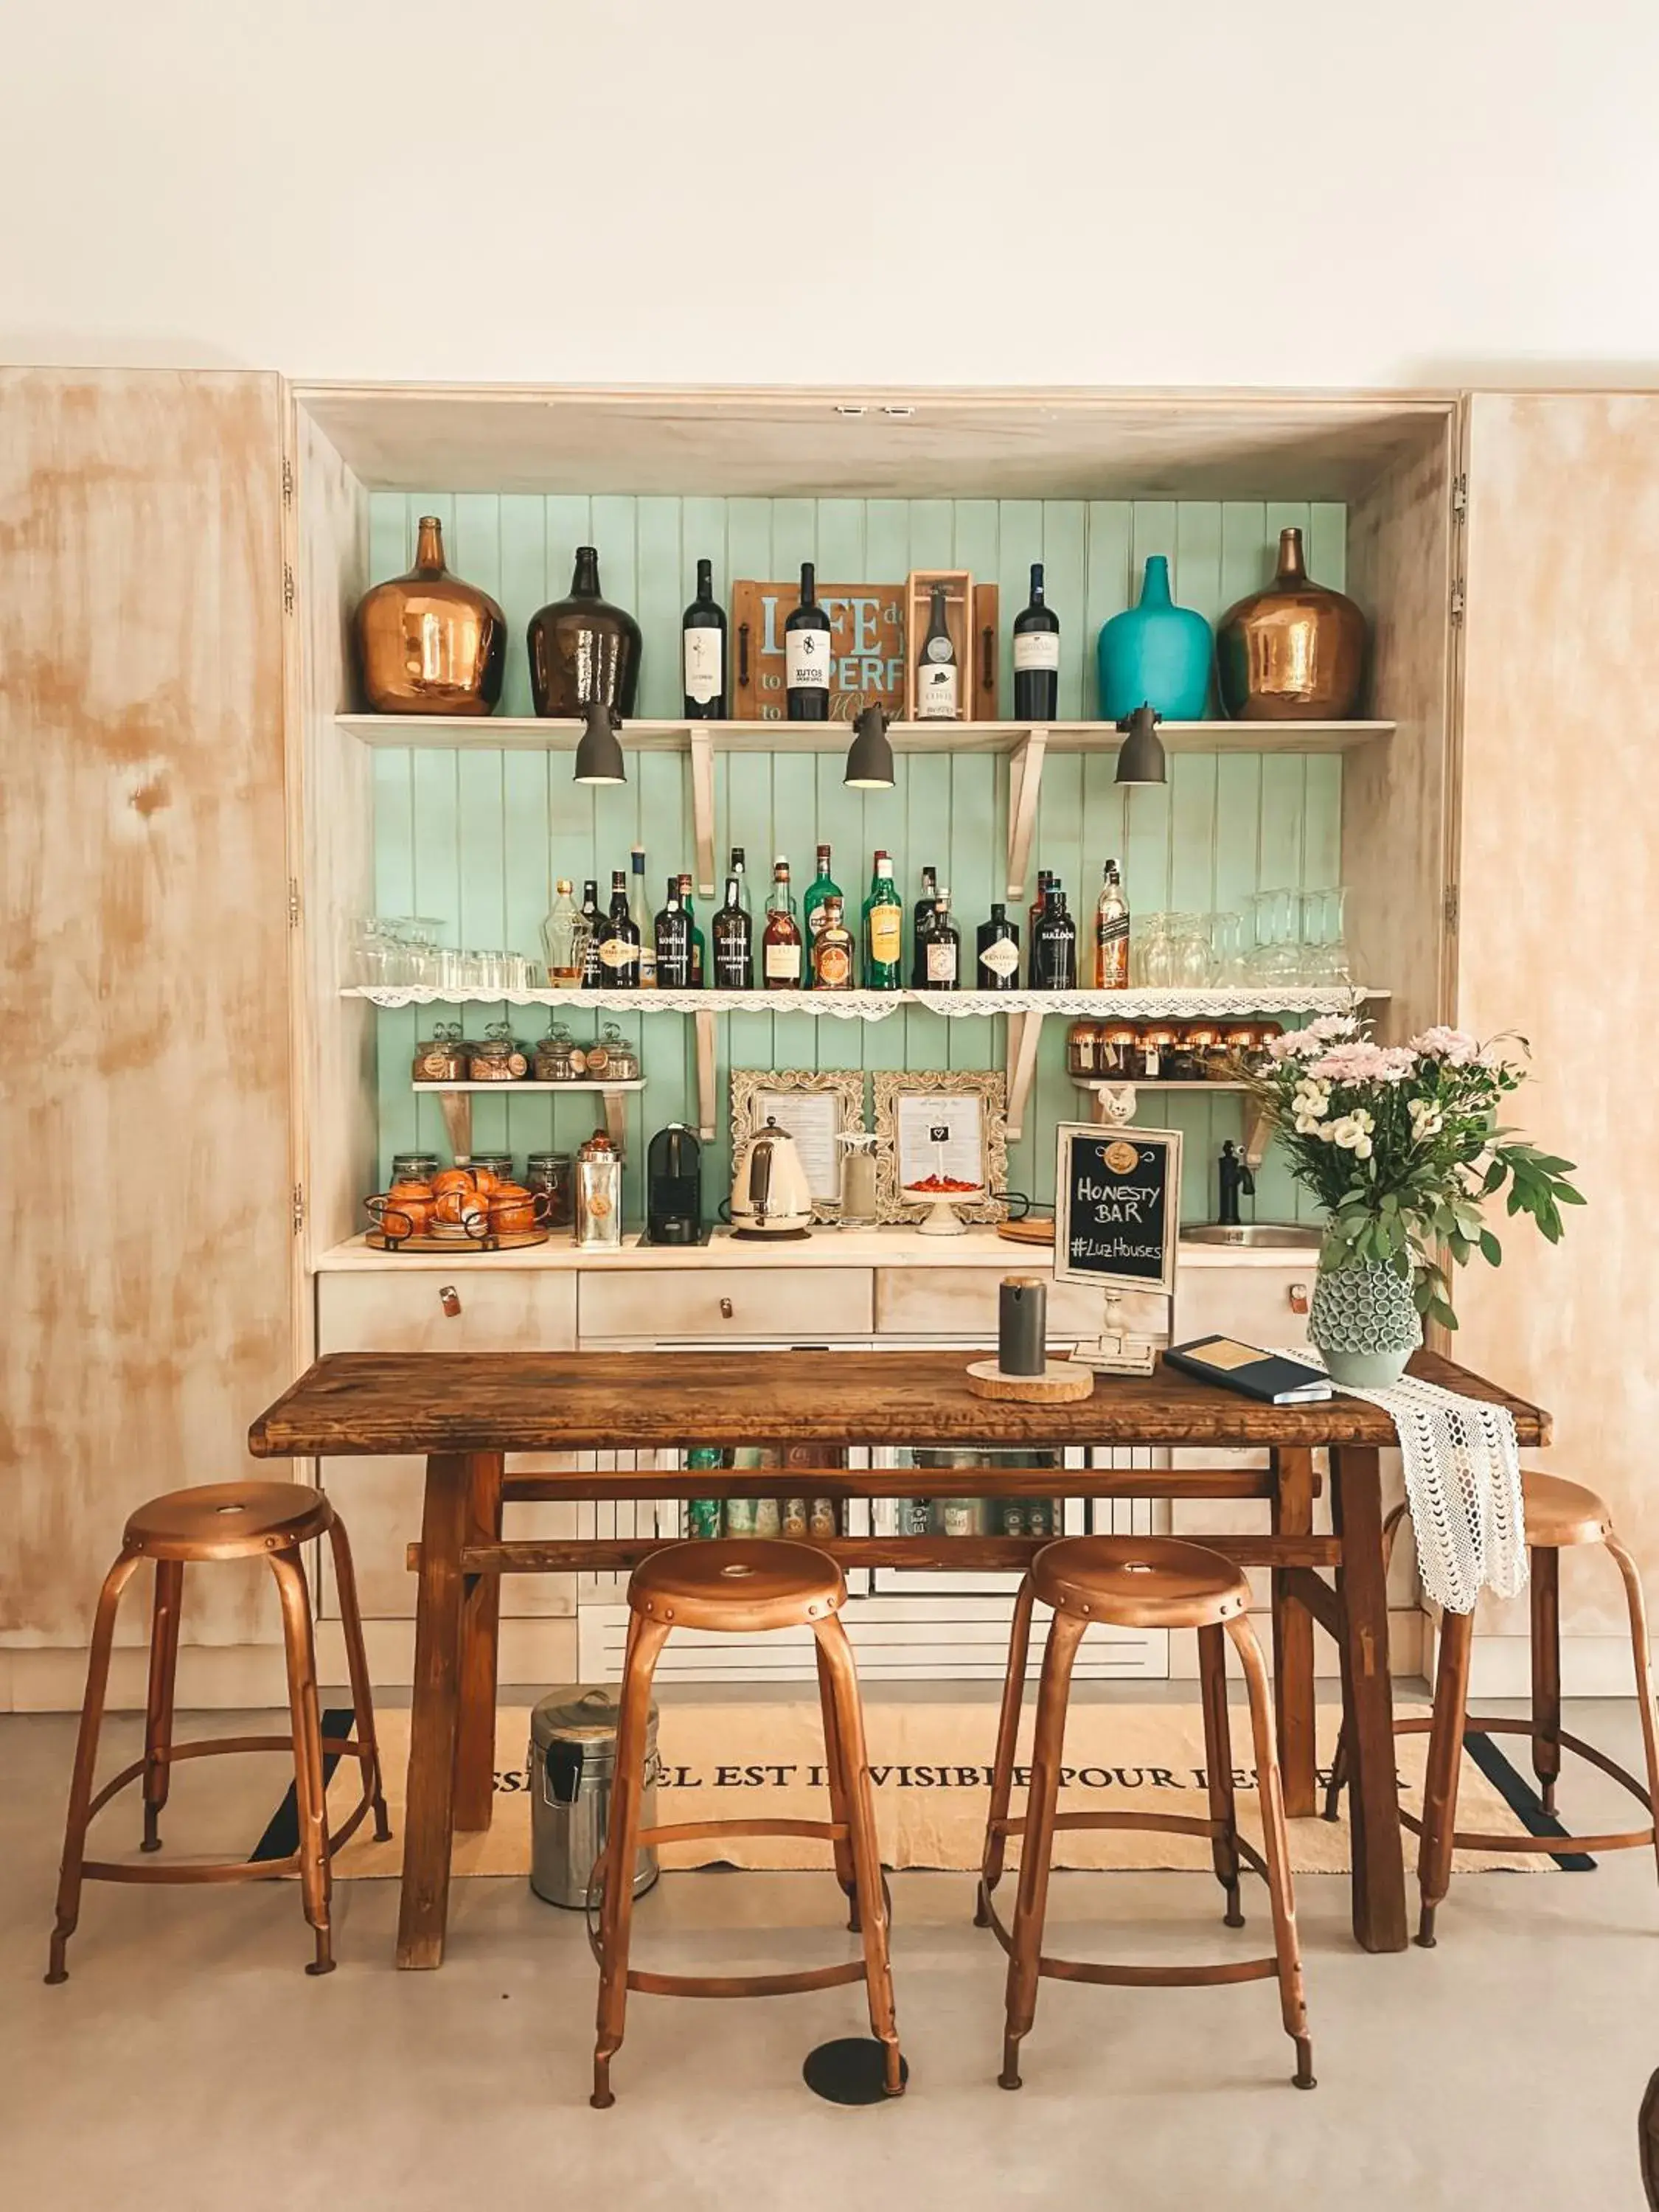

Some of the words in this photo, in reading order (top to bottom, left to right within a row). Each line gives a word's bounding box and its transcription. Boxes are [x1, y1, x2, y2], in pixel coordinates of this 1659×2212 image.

[761, 597, 882, 655] LFE
[762, 673, 781, 690] to
[762, 705, 782, 720] to
[1077, 1177, 1161, 1208] HONESTY
[1094, 1201, 1142, 1224] BAR
[713, 1765, 797, 1787] EST
[1058, 1767, 1186, 1789] POUR
